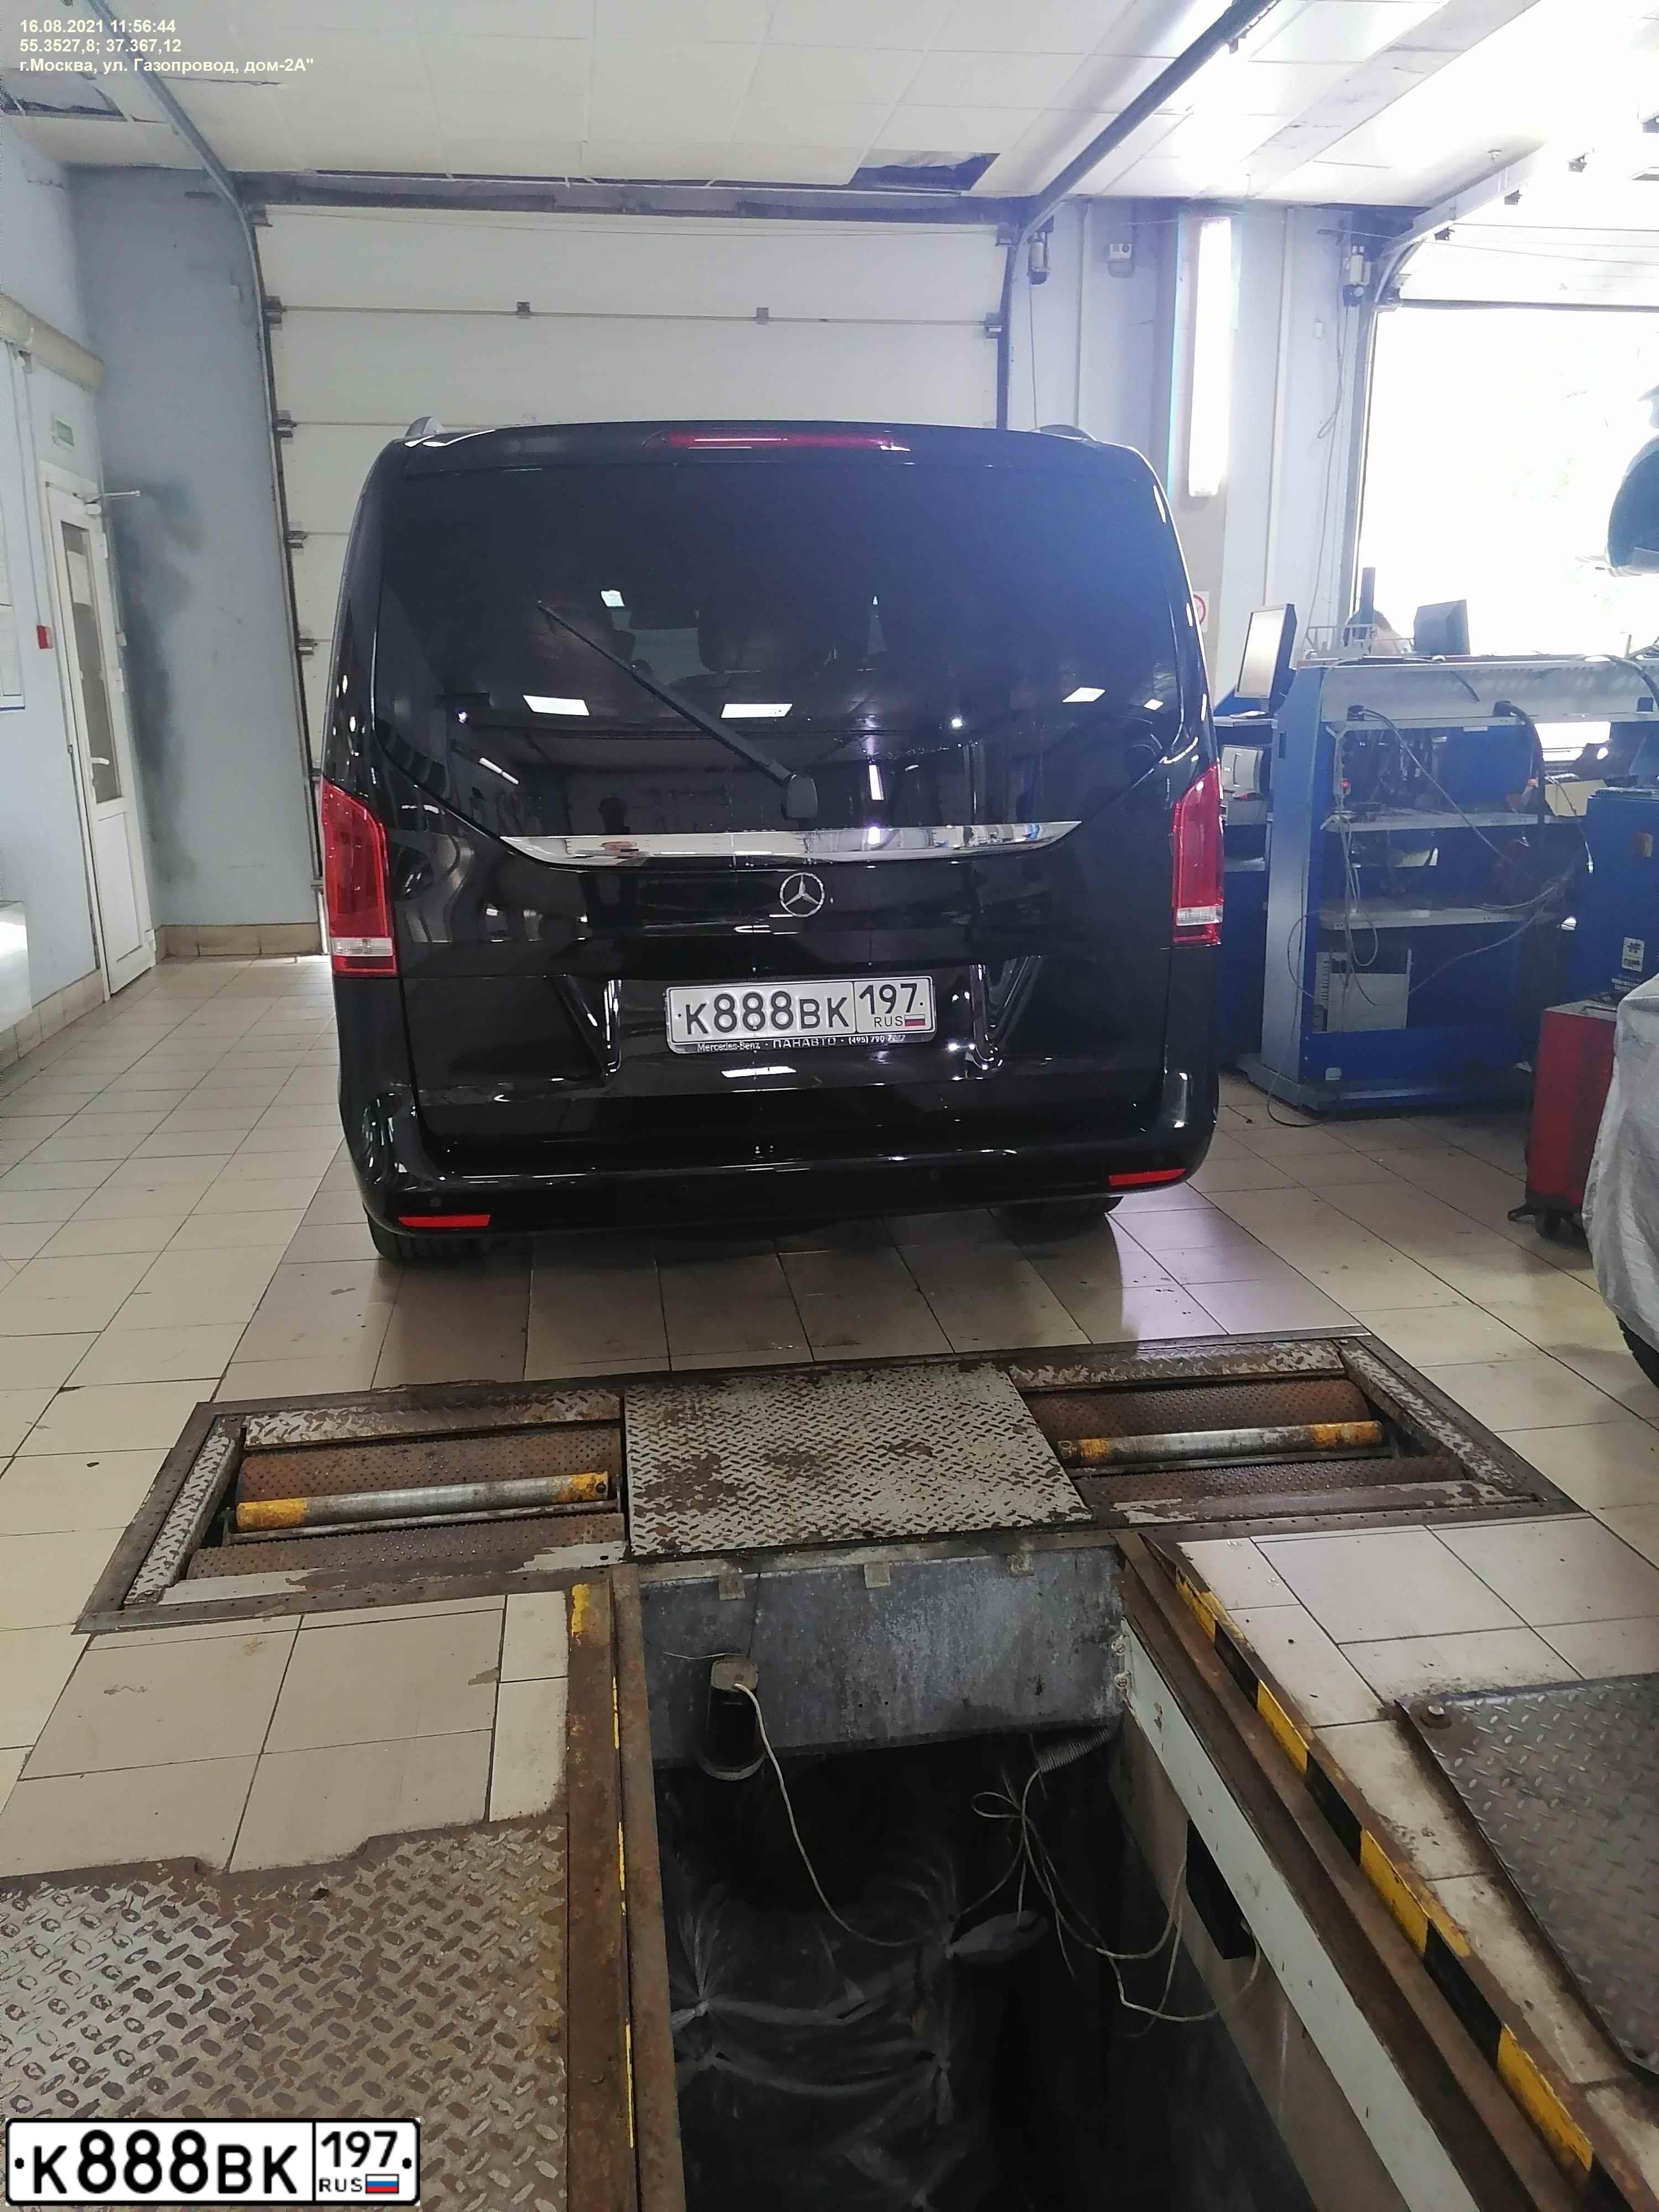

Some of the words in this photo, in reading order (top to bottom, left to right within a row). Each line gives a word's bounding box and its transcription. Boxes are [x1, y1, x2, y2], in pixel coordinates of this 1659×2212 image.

[859, 983, 917, 1015] 197
[874, 1016, 903, 1027] RUS
[697, 1041, 761, 1052] Mercedes-Benz
[773, 1037, 836, 1048] ПАНАВТО
[848, 1035, 869, 1044] (495)
